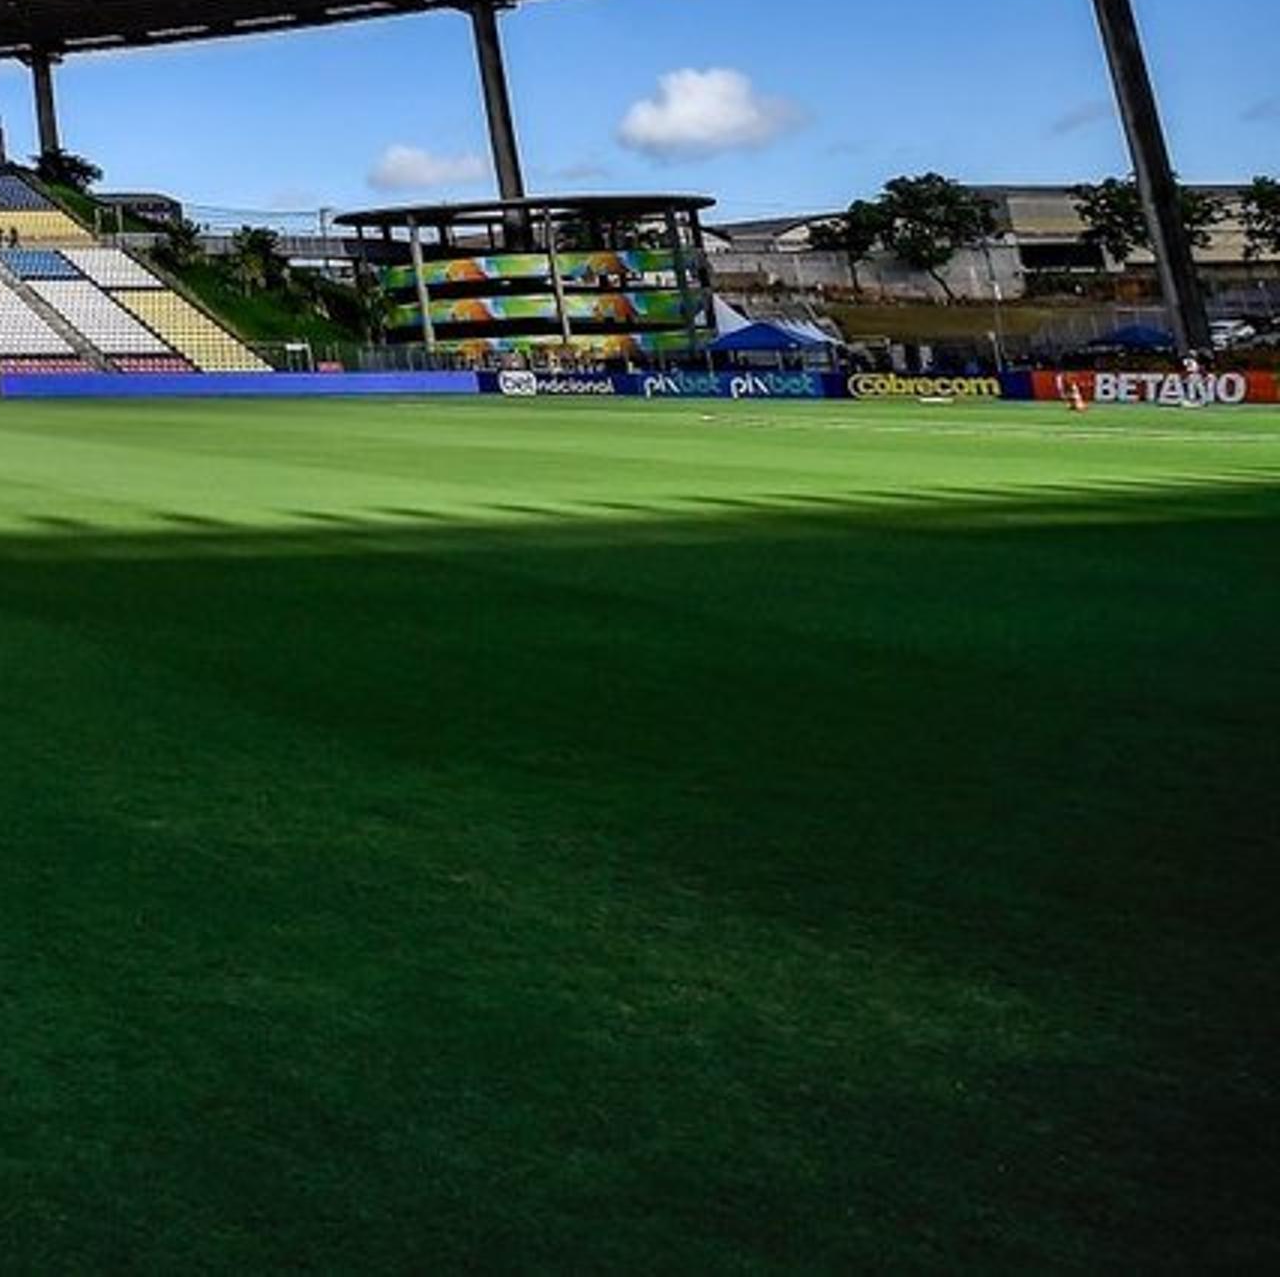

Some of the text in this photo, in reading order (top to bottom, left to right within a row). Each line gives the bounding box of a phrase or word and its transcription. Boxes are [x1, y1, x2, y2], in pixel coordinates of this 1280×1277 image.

[644, 374, 721, 399] pixbet
[730, 373, 814, 399] pixbet
[849, 373, 1002, 396] cobrecom
[1096, 373, 1247, 404] BETANO
